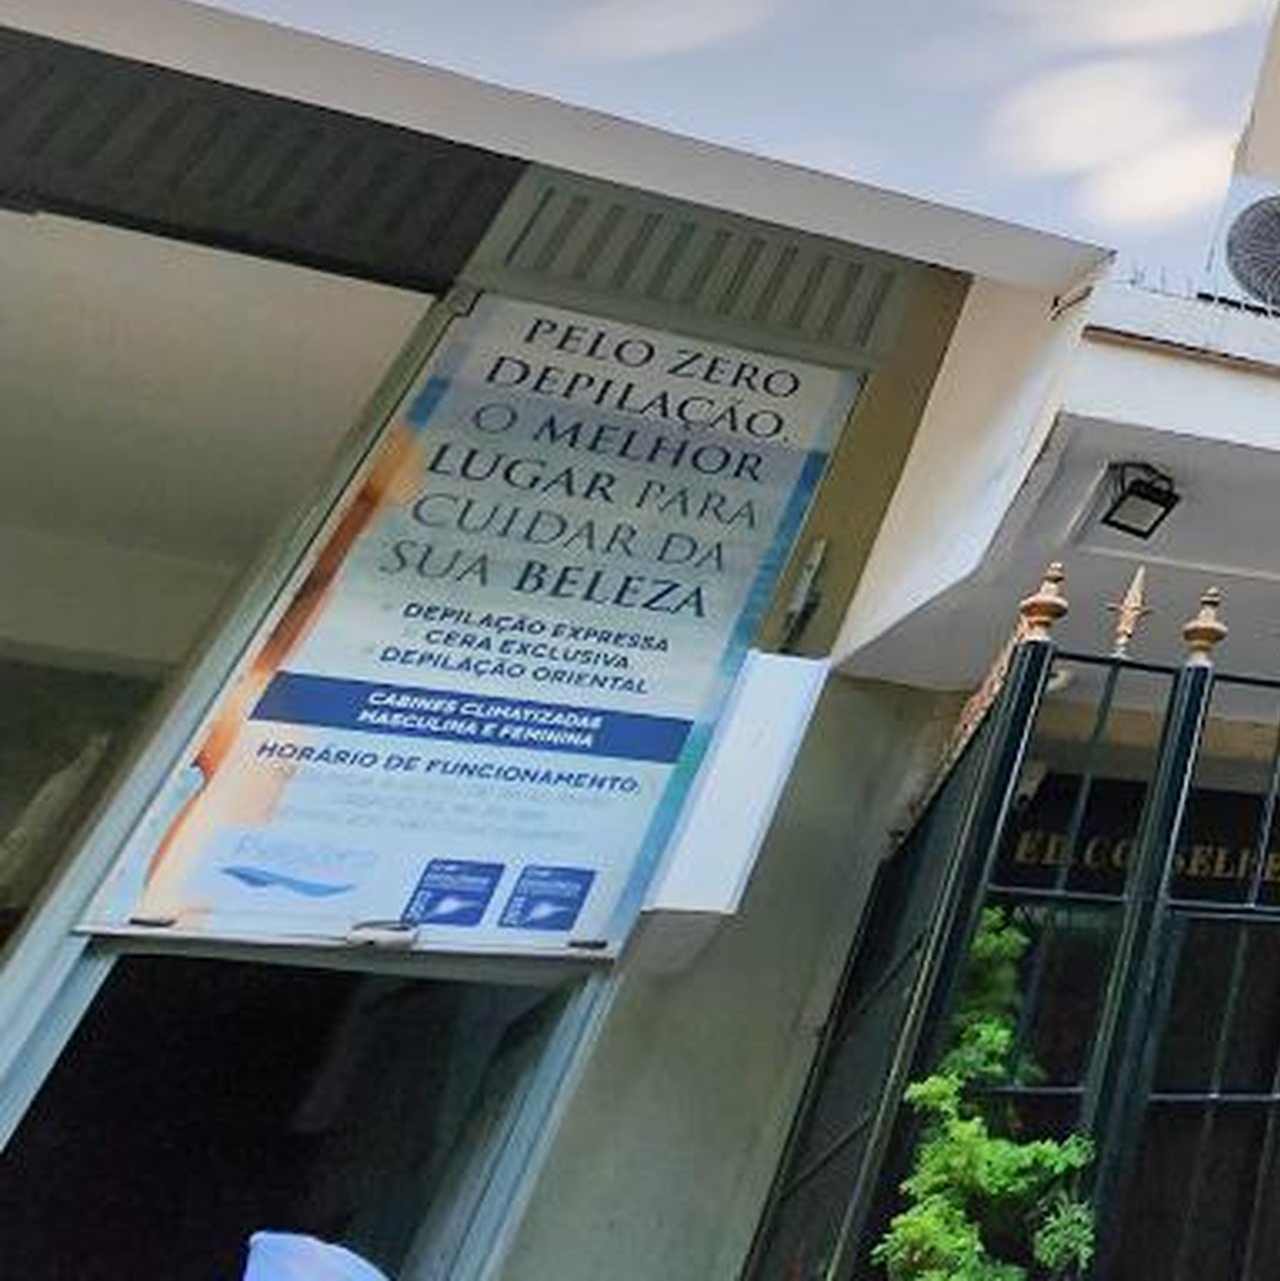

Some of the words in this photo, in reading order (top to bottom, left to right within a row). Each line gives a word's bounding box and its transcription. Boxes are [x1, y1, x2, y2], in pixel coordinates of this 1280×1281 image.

[523, 316, 656, 369] PELO
[668, 348, 801, 399] ZERO
[485, 355, 790, 443] DEPILAÇÃO.
[474, 402, 518, 434] O
[532, 414, 765, 482] MELHOR
[425, 441, 616, 503] LUGAR
[636, 478, 758, 530] PARA
[410, 492, 638, 557] CUIDAR
[656, 531, 726, 572] DA
[379, 537, 490, 586] SUA
[513, 559, 707, 618] BELEZA
[402, 601, 547, 638] DEPILAÇÃO
[552, 622, 670, 653] EXPRESSA
[424, 629, 493, 653] CERA
[498, 638, 631, 671] EXCLUSIVA
[378, 645, 527, 681] DEPILAÇÃO
[531, 665, 651, 696] ORIENTAL
[357, 707, 477, 737] MASCULINA
[481, 722, 497, 738] E
[499, 724, 595, 750] FEMININA
[367, 690, 459, 716] CABINES
[459, 701, 604, 731] CLIMATIZADAS
[255, 739, 380, 770] HORÁRIO
[383, 751, 422, 773] DE
